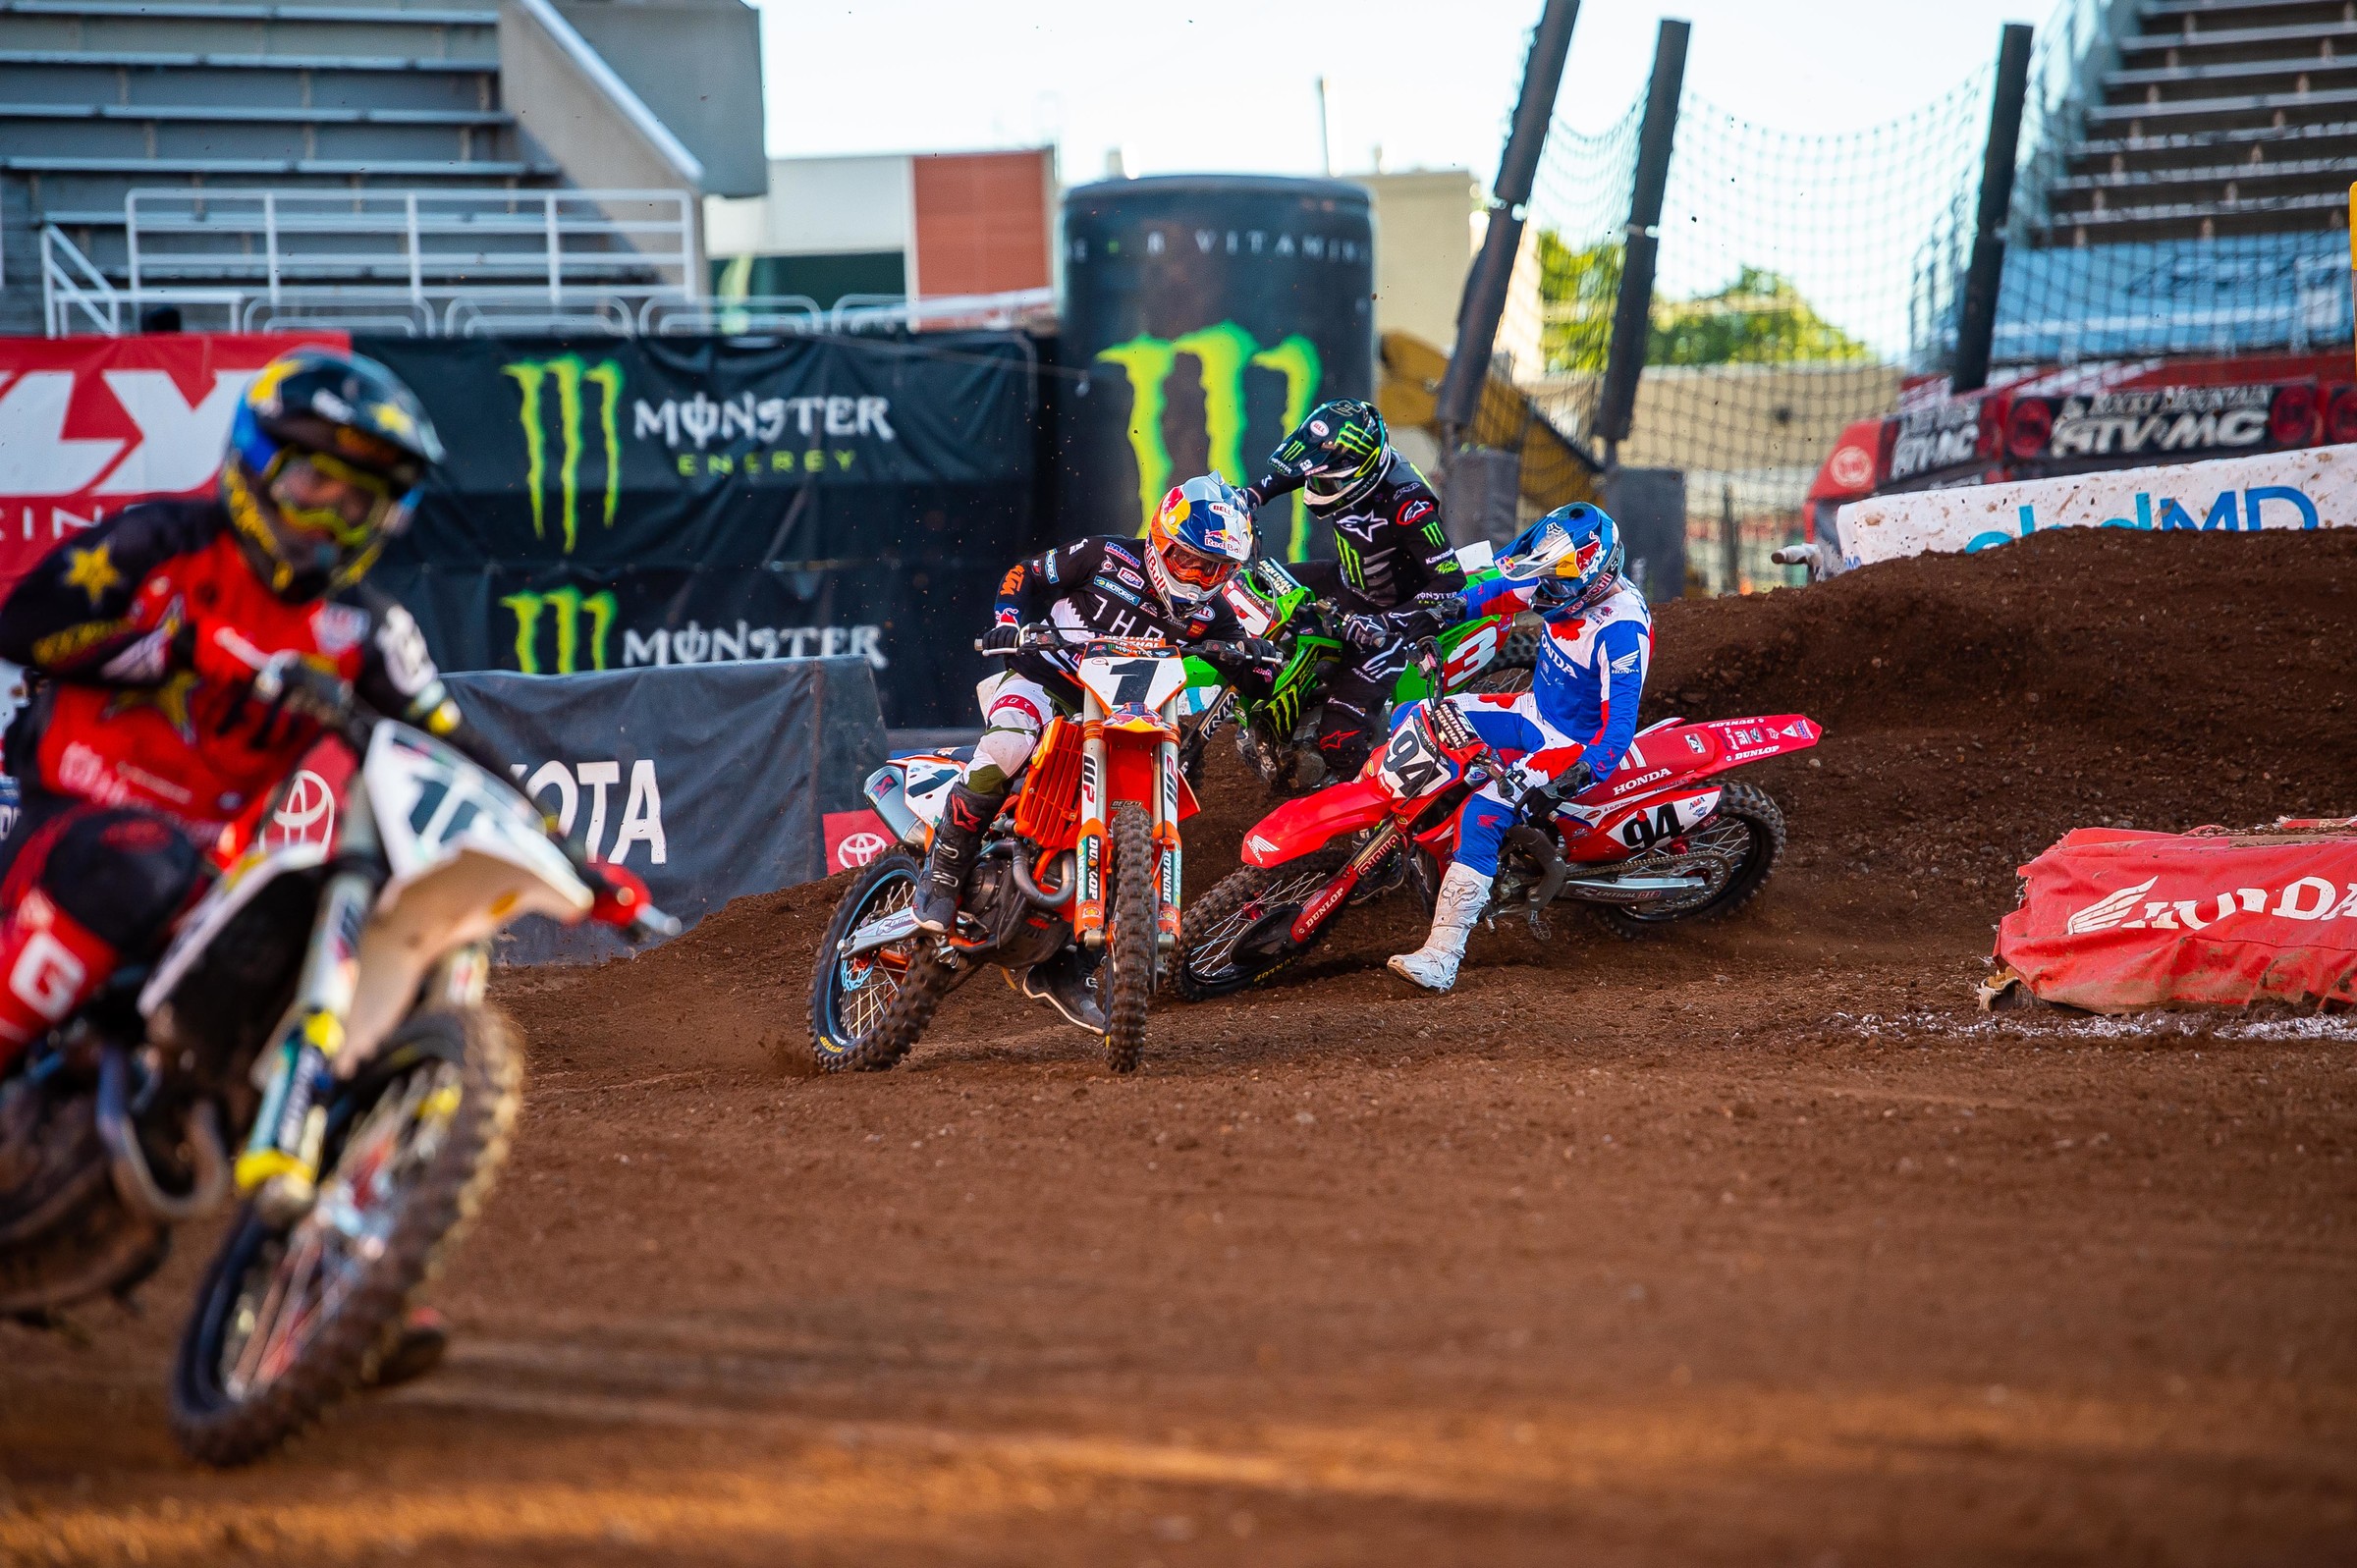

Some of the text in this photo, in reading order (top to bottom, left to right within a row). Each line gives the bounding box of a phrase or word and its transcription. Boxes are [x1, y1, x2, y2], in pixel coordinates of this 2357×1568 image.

[1194, 228, 1370, 265] VITAMIN
[0, 369, 257, 497] LY
[632, 392, 896, 448] MONSTER
[677, 449, 858, 477] ENERGY
[1213, 505, 1233, 515] BELL
[1205, 537, 1227, 550] Red
[1581, 543, 1608, 584] FOX
[1000, 565, 1025, 596] KTM
[1104, 581, 1136, 604] MOTOREX
[1120, 568, 1142, 587] 100%
[1447, 625, 1498, 687] 3
[1541, 631, 1578, 679] ONDA
[1109, 659, 1160, 706] 1
[1434, 709, 1463, 749] RENTHAL
[1441, 703, 1470, 743] RENTHAL
[1383, 730, 1444, 798] 94
[1734, 745, 1781, 761] DUNLOP
[1083, 753, 1098, 804] WP
[1613, 767, 1672, 797] HONDA
[510, 759, 669, 865] OTA
[1622, 802, 1685, 853] 94
[1087, 837, 1099, 901] DULOP
[1246, 839, 1264, 864] HONDA
[1305, 887, 1344, 929] DUNLOP
